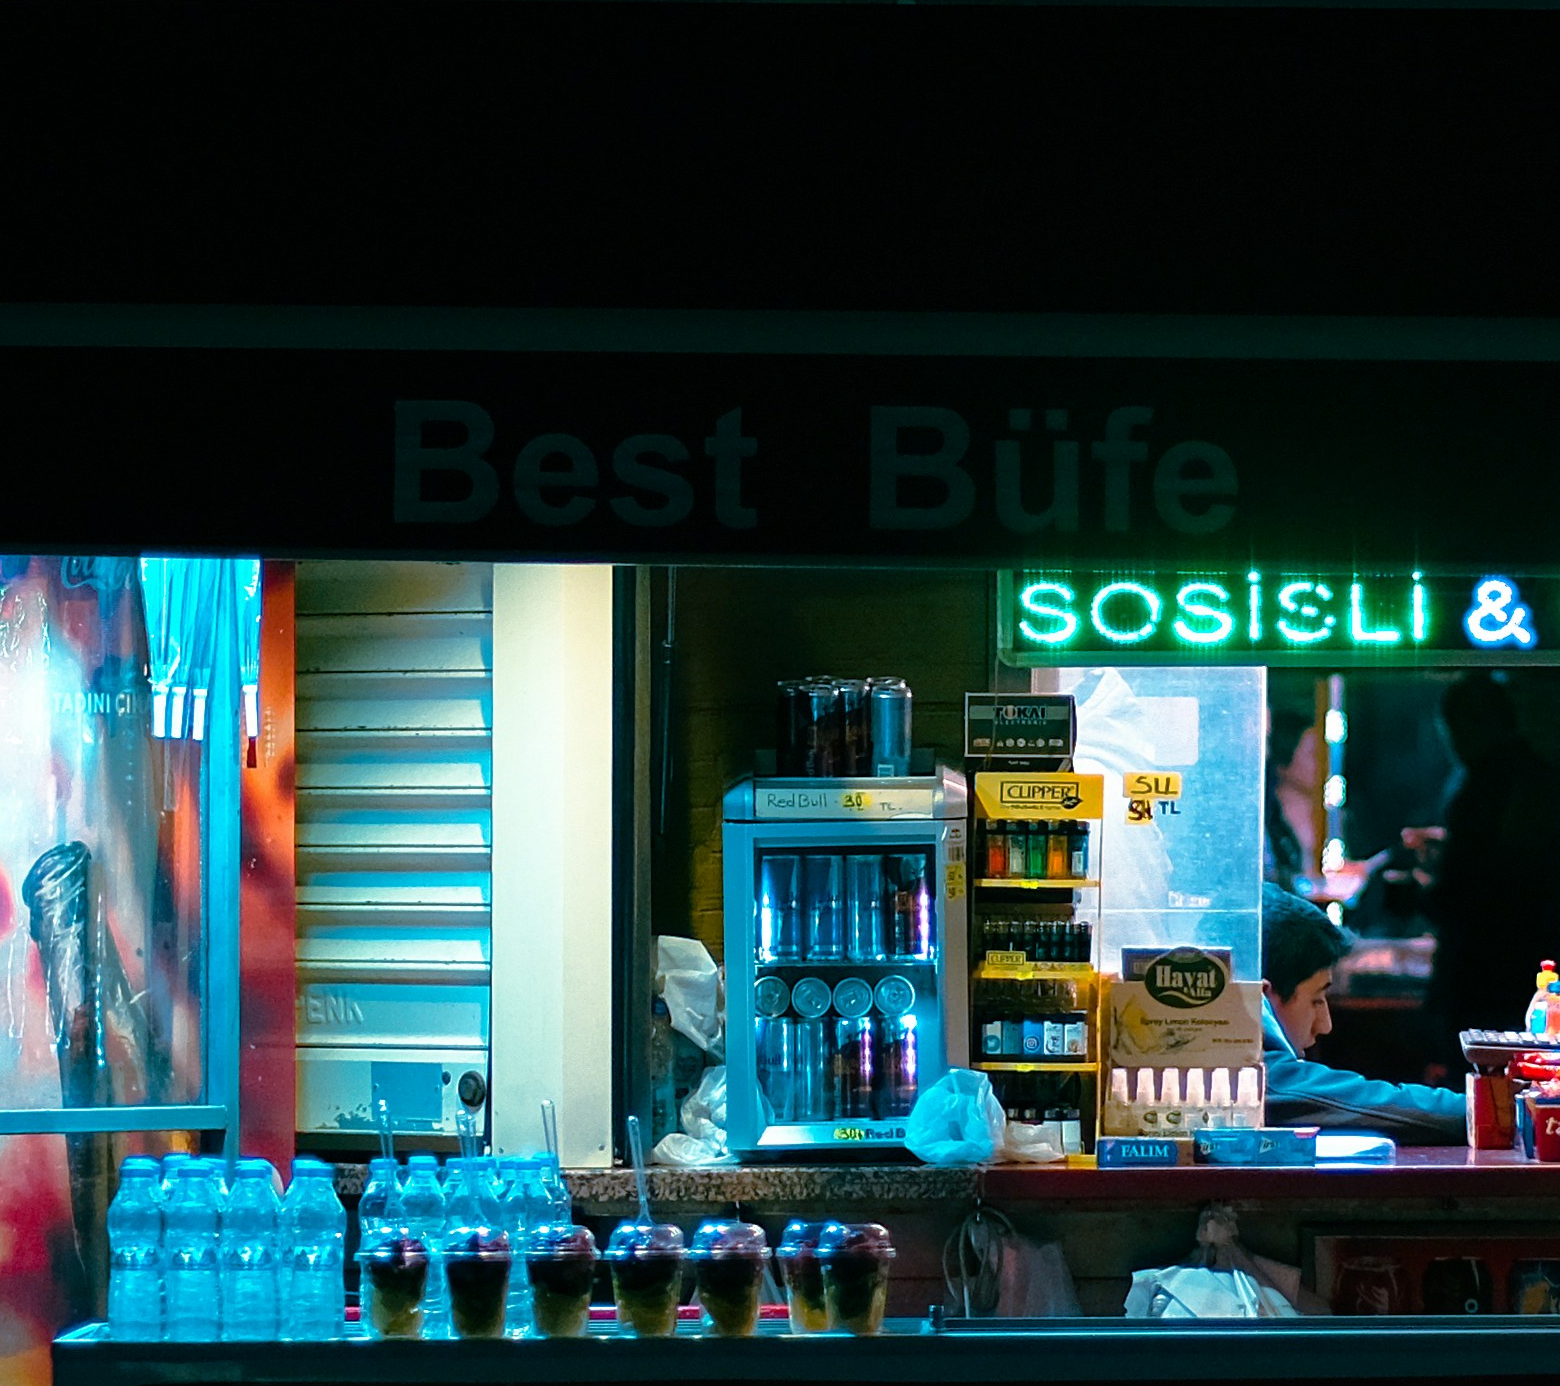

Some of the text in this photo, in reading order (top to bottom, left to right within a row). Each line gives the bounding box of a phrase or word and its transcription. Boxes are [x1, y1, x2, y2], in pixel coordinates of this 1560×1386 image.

[391, 397, 1239, 536] Best Büfe
[1463, 577, 1534, 648] &
[993, 704, 1047, 719] TOKAI
[767, 793, 795, 808] Red
[798, 793, 828, 808] Bull
[1006, 784, 1072, 800] CLIPPER
[1154, 964, 1218, 991] Hayat
